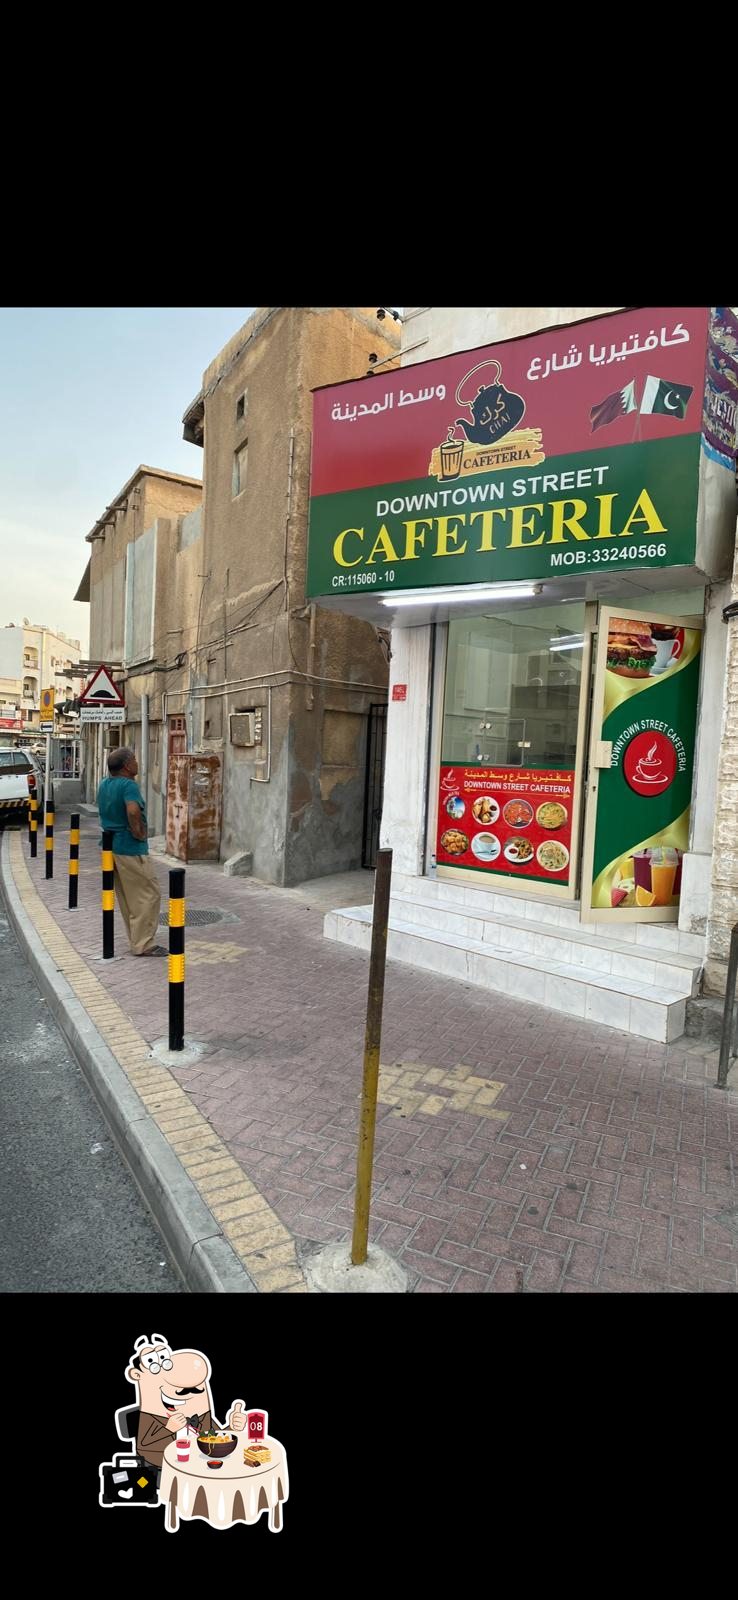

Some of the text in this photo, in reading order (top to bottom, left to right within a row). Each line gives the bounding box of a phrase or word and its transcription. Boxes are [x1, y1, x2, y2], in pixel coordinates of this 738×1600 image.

[526, 323, 690, 381] كافتيريا شارع
[331, 384, 446, 422] وسط المدينة
[489, 412, 512, 434] CHAI
[463, 449, 531, 469] CAFETERIA
[376, 466, 610, 517] DOWNTOWN STREET
[332, 488, 669, 568] CAFETERIA
[550, 543, 667, 567] MOB:33240566
[332, 572, 377, 587] CR:115060
[384, 570, 395, 583] 10
[610, 719, 687, 772] DOWNTOWN STREET CAFETERIA
[464, 769, 572, 783] كافتيريا شارع وسط المدينة
[464, 780, 571, 794] DOWNTOWN STREET CAFETERIA
